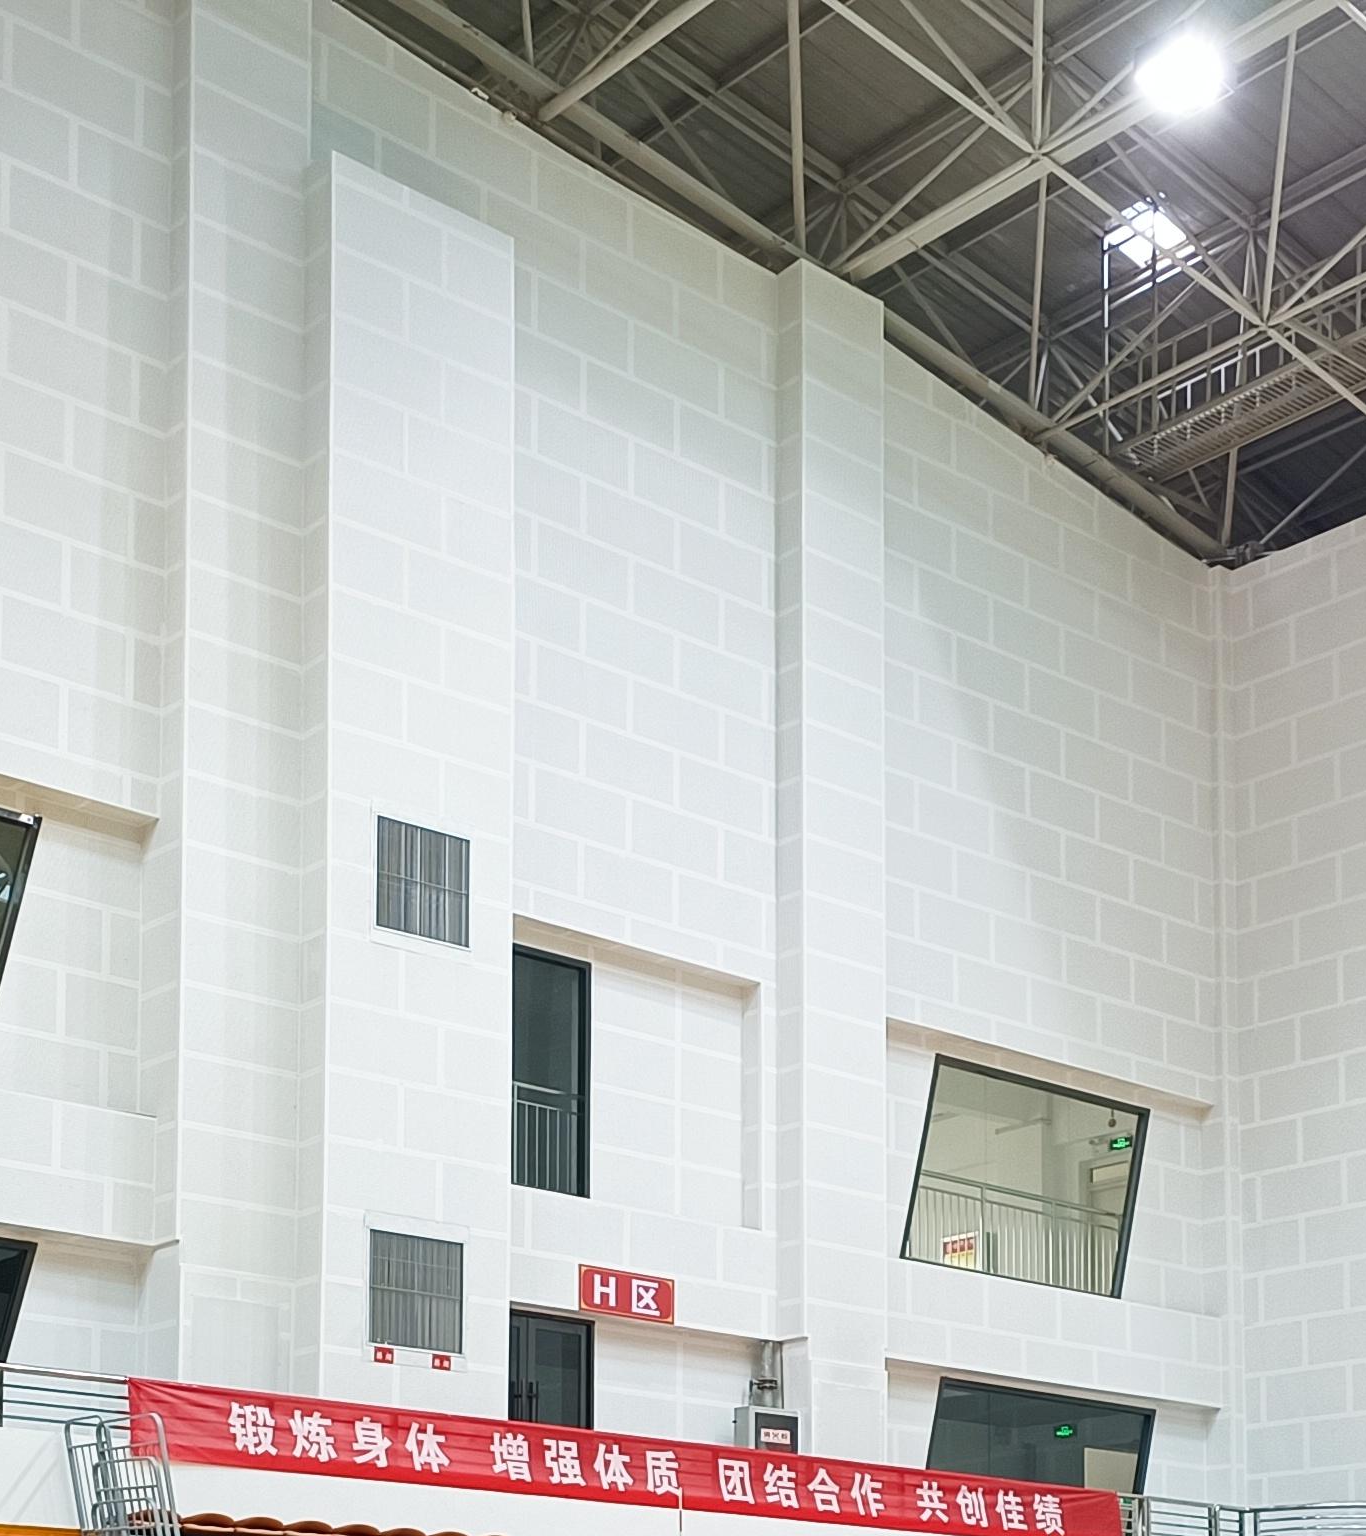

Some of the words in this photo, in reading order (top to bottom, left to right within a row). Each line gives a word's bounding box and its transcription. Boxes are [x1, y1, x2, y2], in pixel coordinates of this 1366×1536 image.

[228, 1401, 451, 1473] 锻炼身体
[490, 1432, 683, 1497] 增强体质
[718, 1457, 885, 1518] 团结合作
[915, 1480, 1066, 1536] 共创佳绩
